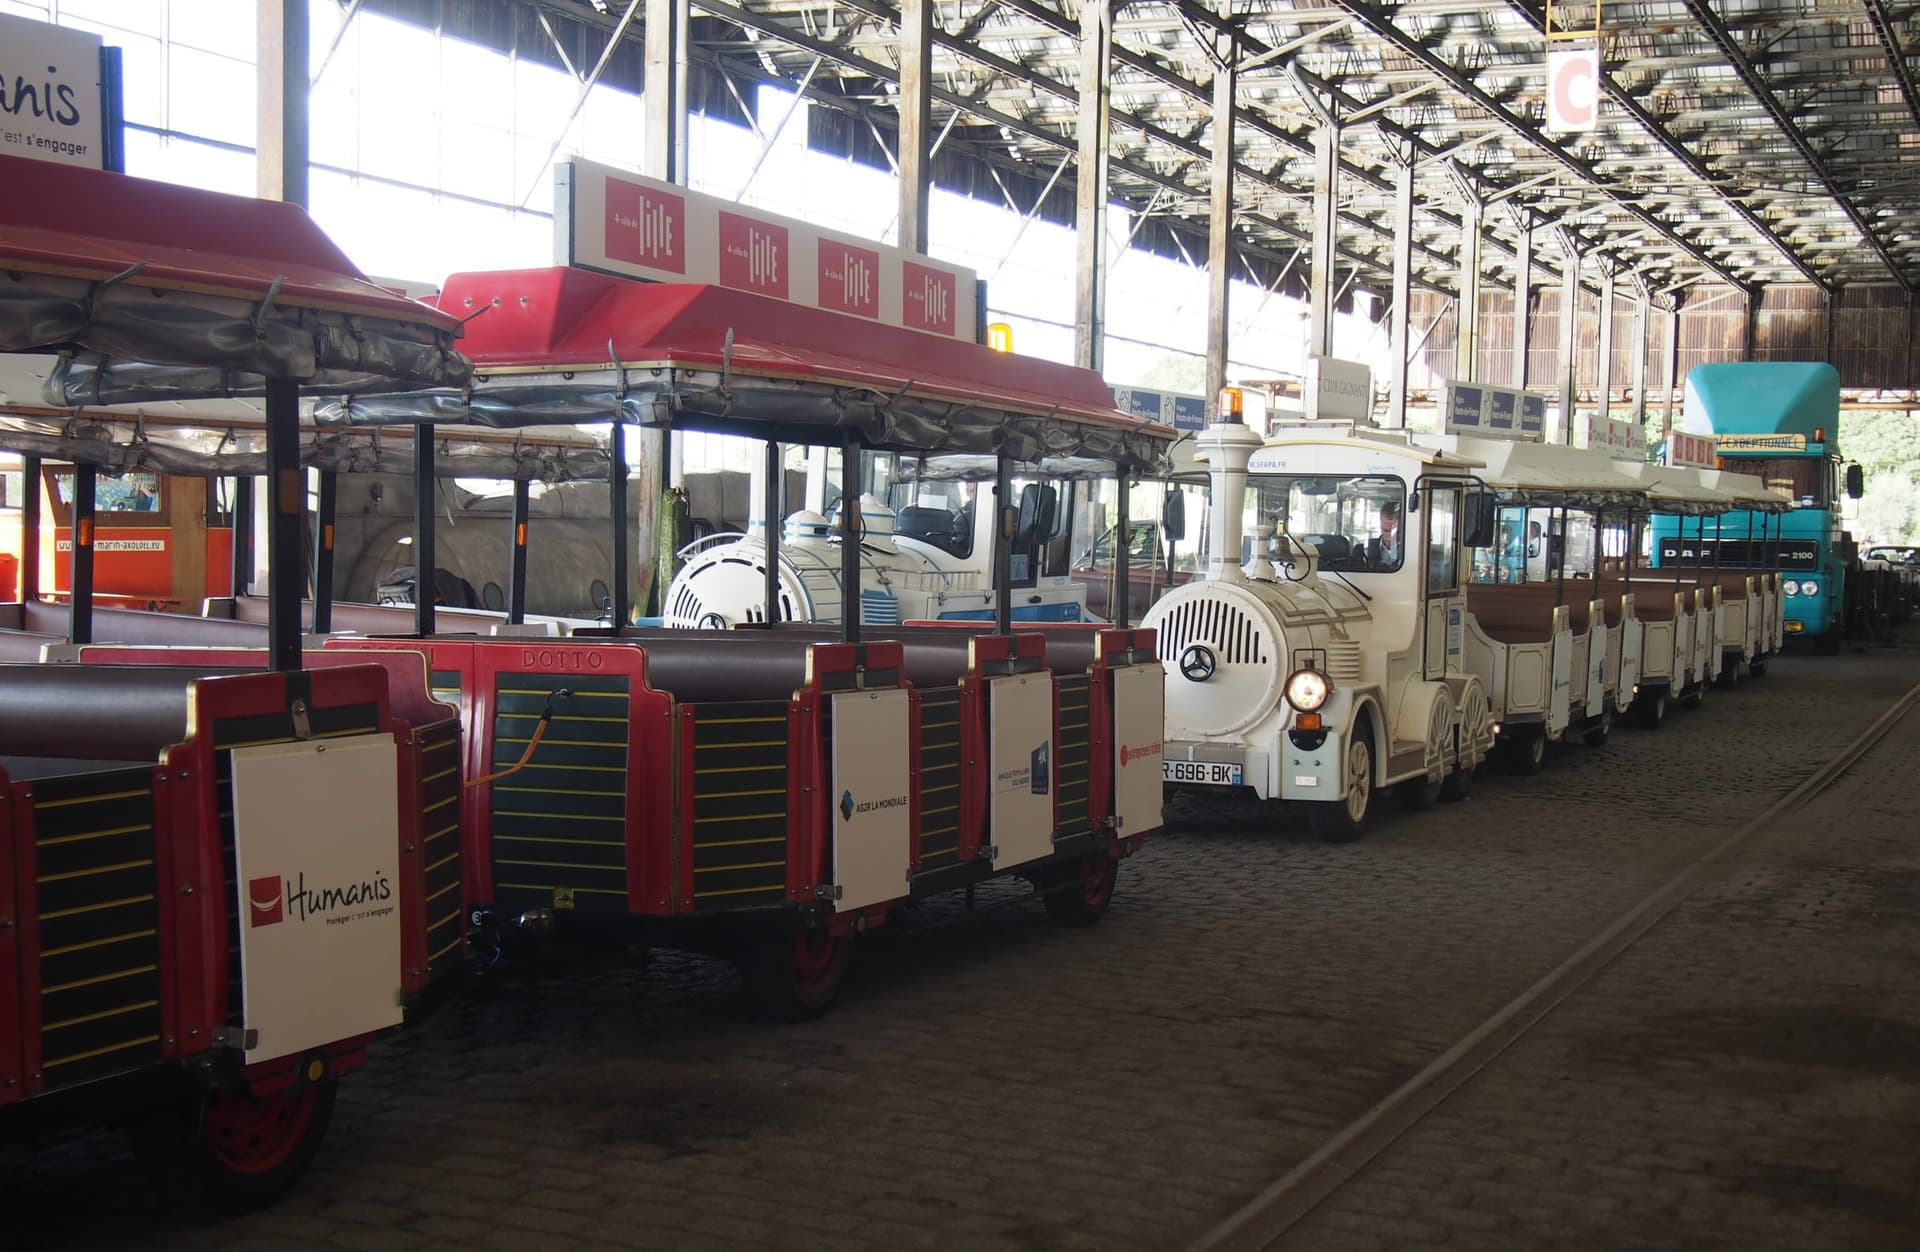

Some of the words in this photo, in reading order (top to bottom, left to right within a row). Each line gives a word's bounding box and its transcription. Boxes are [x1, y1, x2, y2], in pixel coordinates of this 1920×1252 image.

[1554, 58, 1592, 125] C
[26, 133, 87, 156] s'engager
[1664, 549, 1711, 558] DAF
[1791, 551, 1814, 560] 2100
[522, 650, 602, 668] DOTTO
[856, 801, 871, 813] AG2R
[871, 801, 879, 811] LA
[879, 795, 908, 809] MONDIALE
[287, 870, 391, 922] Humanis
